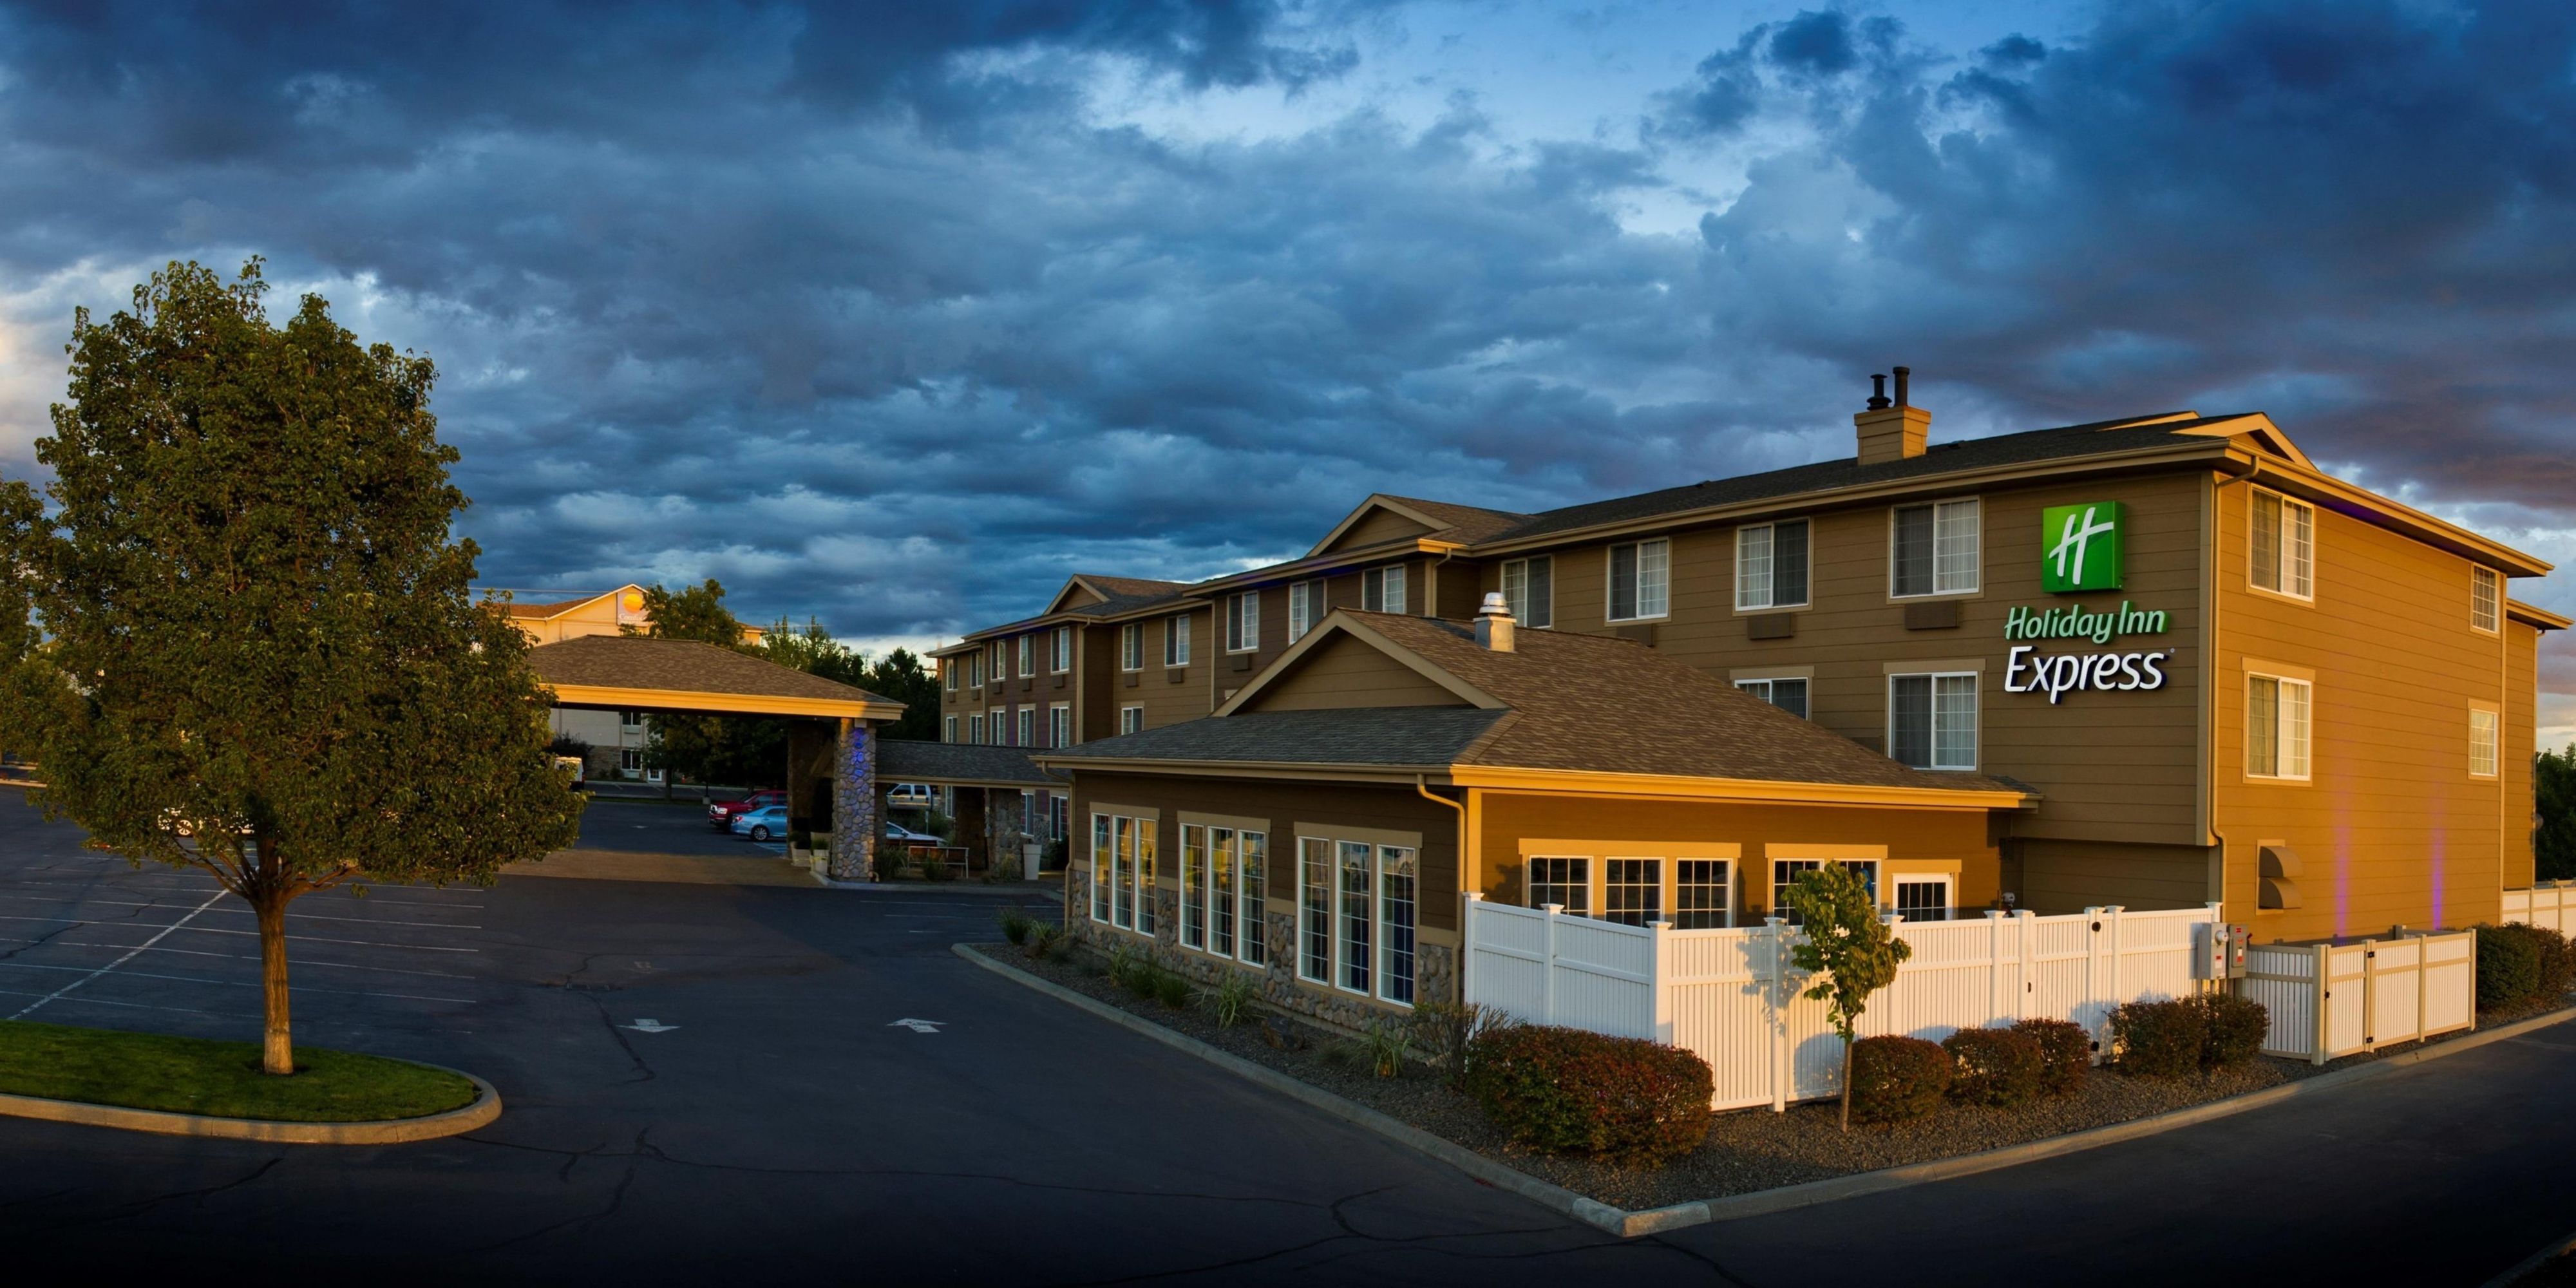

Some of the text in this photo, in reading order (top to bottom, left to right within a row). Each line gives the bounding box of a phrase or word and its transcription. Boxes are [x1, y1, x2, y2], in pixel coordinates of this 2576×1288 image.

[2004, 600, 2166, 644] Holiday Inn
[2004, 646, 2165, 705] Express
